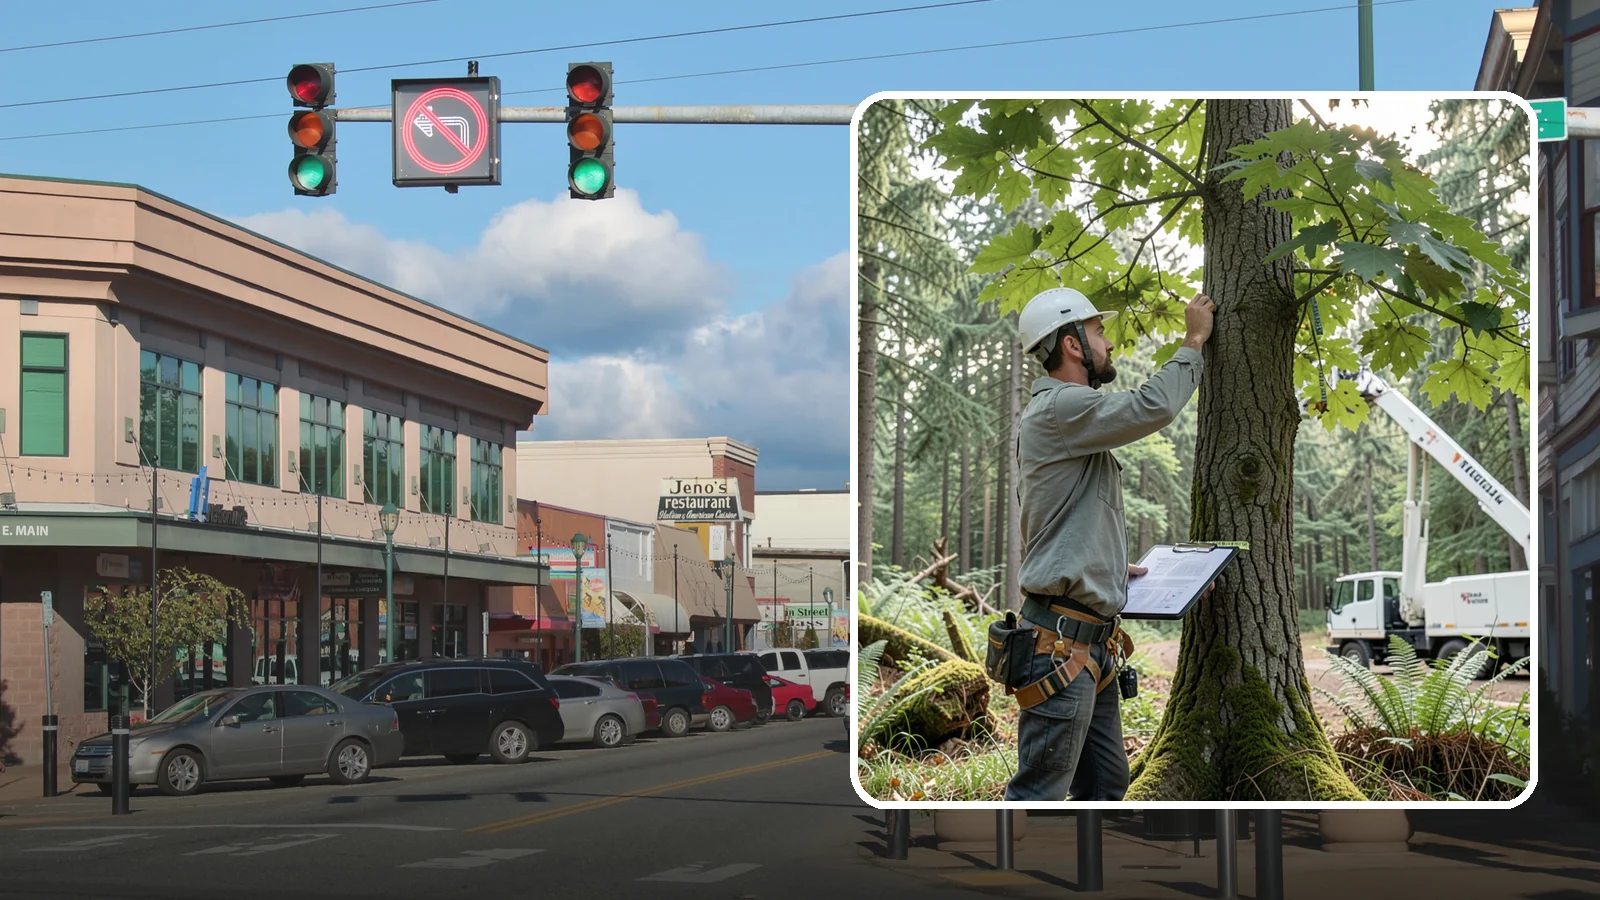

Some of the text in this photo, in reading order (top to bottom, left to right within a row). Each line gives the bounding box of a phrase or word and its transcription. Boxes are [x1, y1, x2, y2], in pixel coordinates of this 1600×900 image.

[669, 480, 728, 494] Jeno's
[665, 496, 731, 509] restaurant
[658, 510, 681, 519] Italian
[686, 510, 715, 519] American
[715, 509, 738, 519] Cuisine
[2, 525, 49, 536] E. MAIN
[786, 608, 828, 616] in Street
